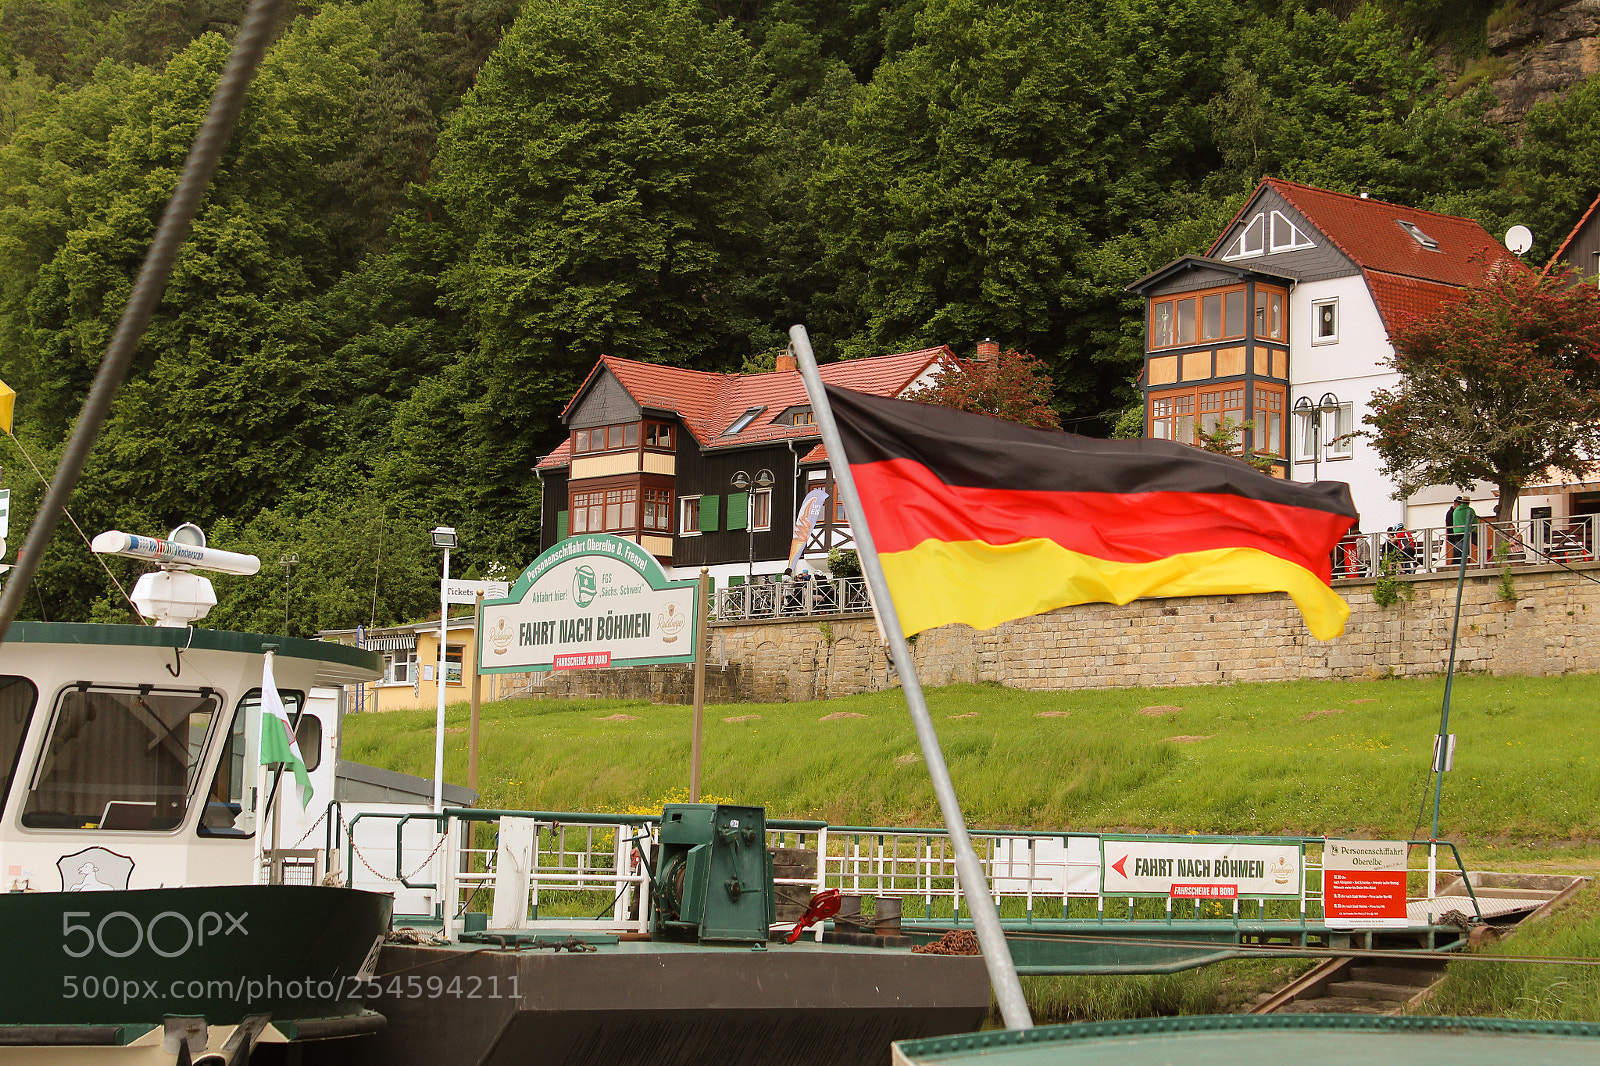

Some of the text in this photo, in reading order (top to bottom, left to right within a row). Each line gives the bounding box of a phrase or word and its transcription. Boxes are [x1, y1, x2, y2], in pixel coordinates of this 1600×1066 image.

[586, 538, 616, 553] Oberelbe
[616, 544, 623, 556] B.
[624, 545, 648, 572] Frenzel
[602, 573, 612, 584] FGS
[447, 587, 474, 596] Tickets
[532, 589, 568, 603] Abfahrt hier!
[519, 610, 651, 646] FAHRT NACH BÖHMEN
[1341, 846, 1403, 856] Personenschiffahrt
[1134, 855, 1265, 879] FAHRT NACH BÖHMEN
[1352, 857, 1382, 866] Oberelbe
[1219, 887, 1235, 896] BORD
